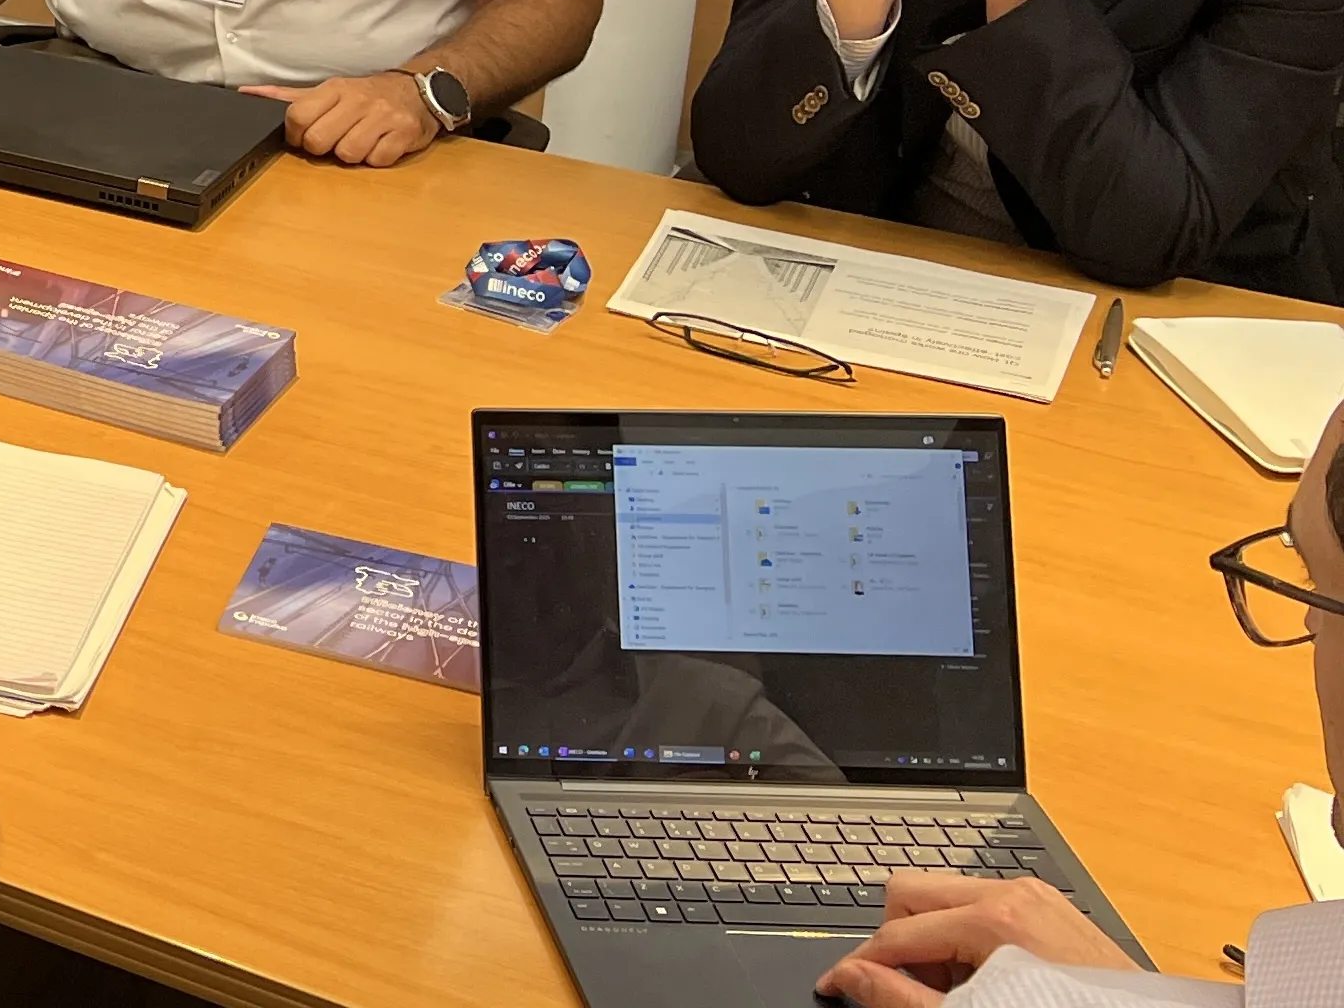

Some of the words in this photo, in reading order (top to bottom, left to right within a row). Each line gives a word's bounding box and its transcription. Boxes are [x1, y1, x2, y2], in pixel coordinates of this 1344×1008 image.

[502, 280, 546, 303] ineco
[506, 501, 535, 511] INECO
[409, 616, 424, 626] in
[427, 620, 453, 632] the
[447, 617, 464, 625] of
[349, 621, 414, 641] railways
[354, 613, 370, 621] of
[373, 616, 398, 628] the
[401, 622, 480, 648] high-spe
